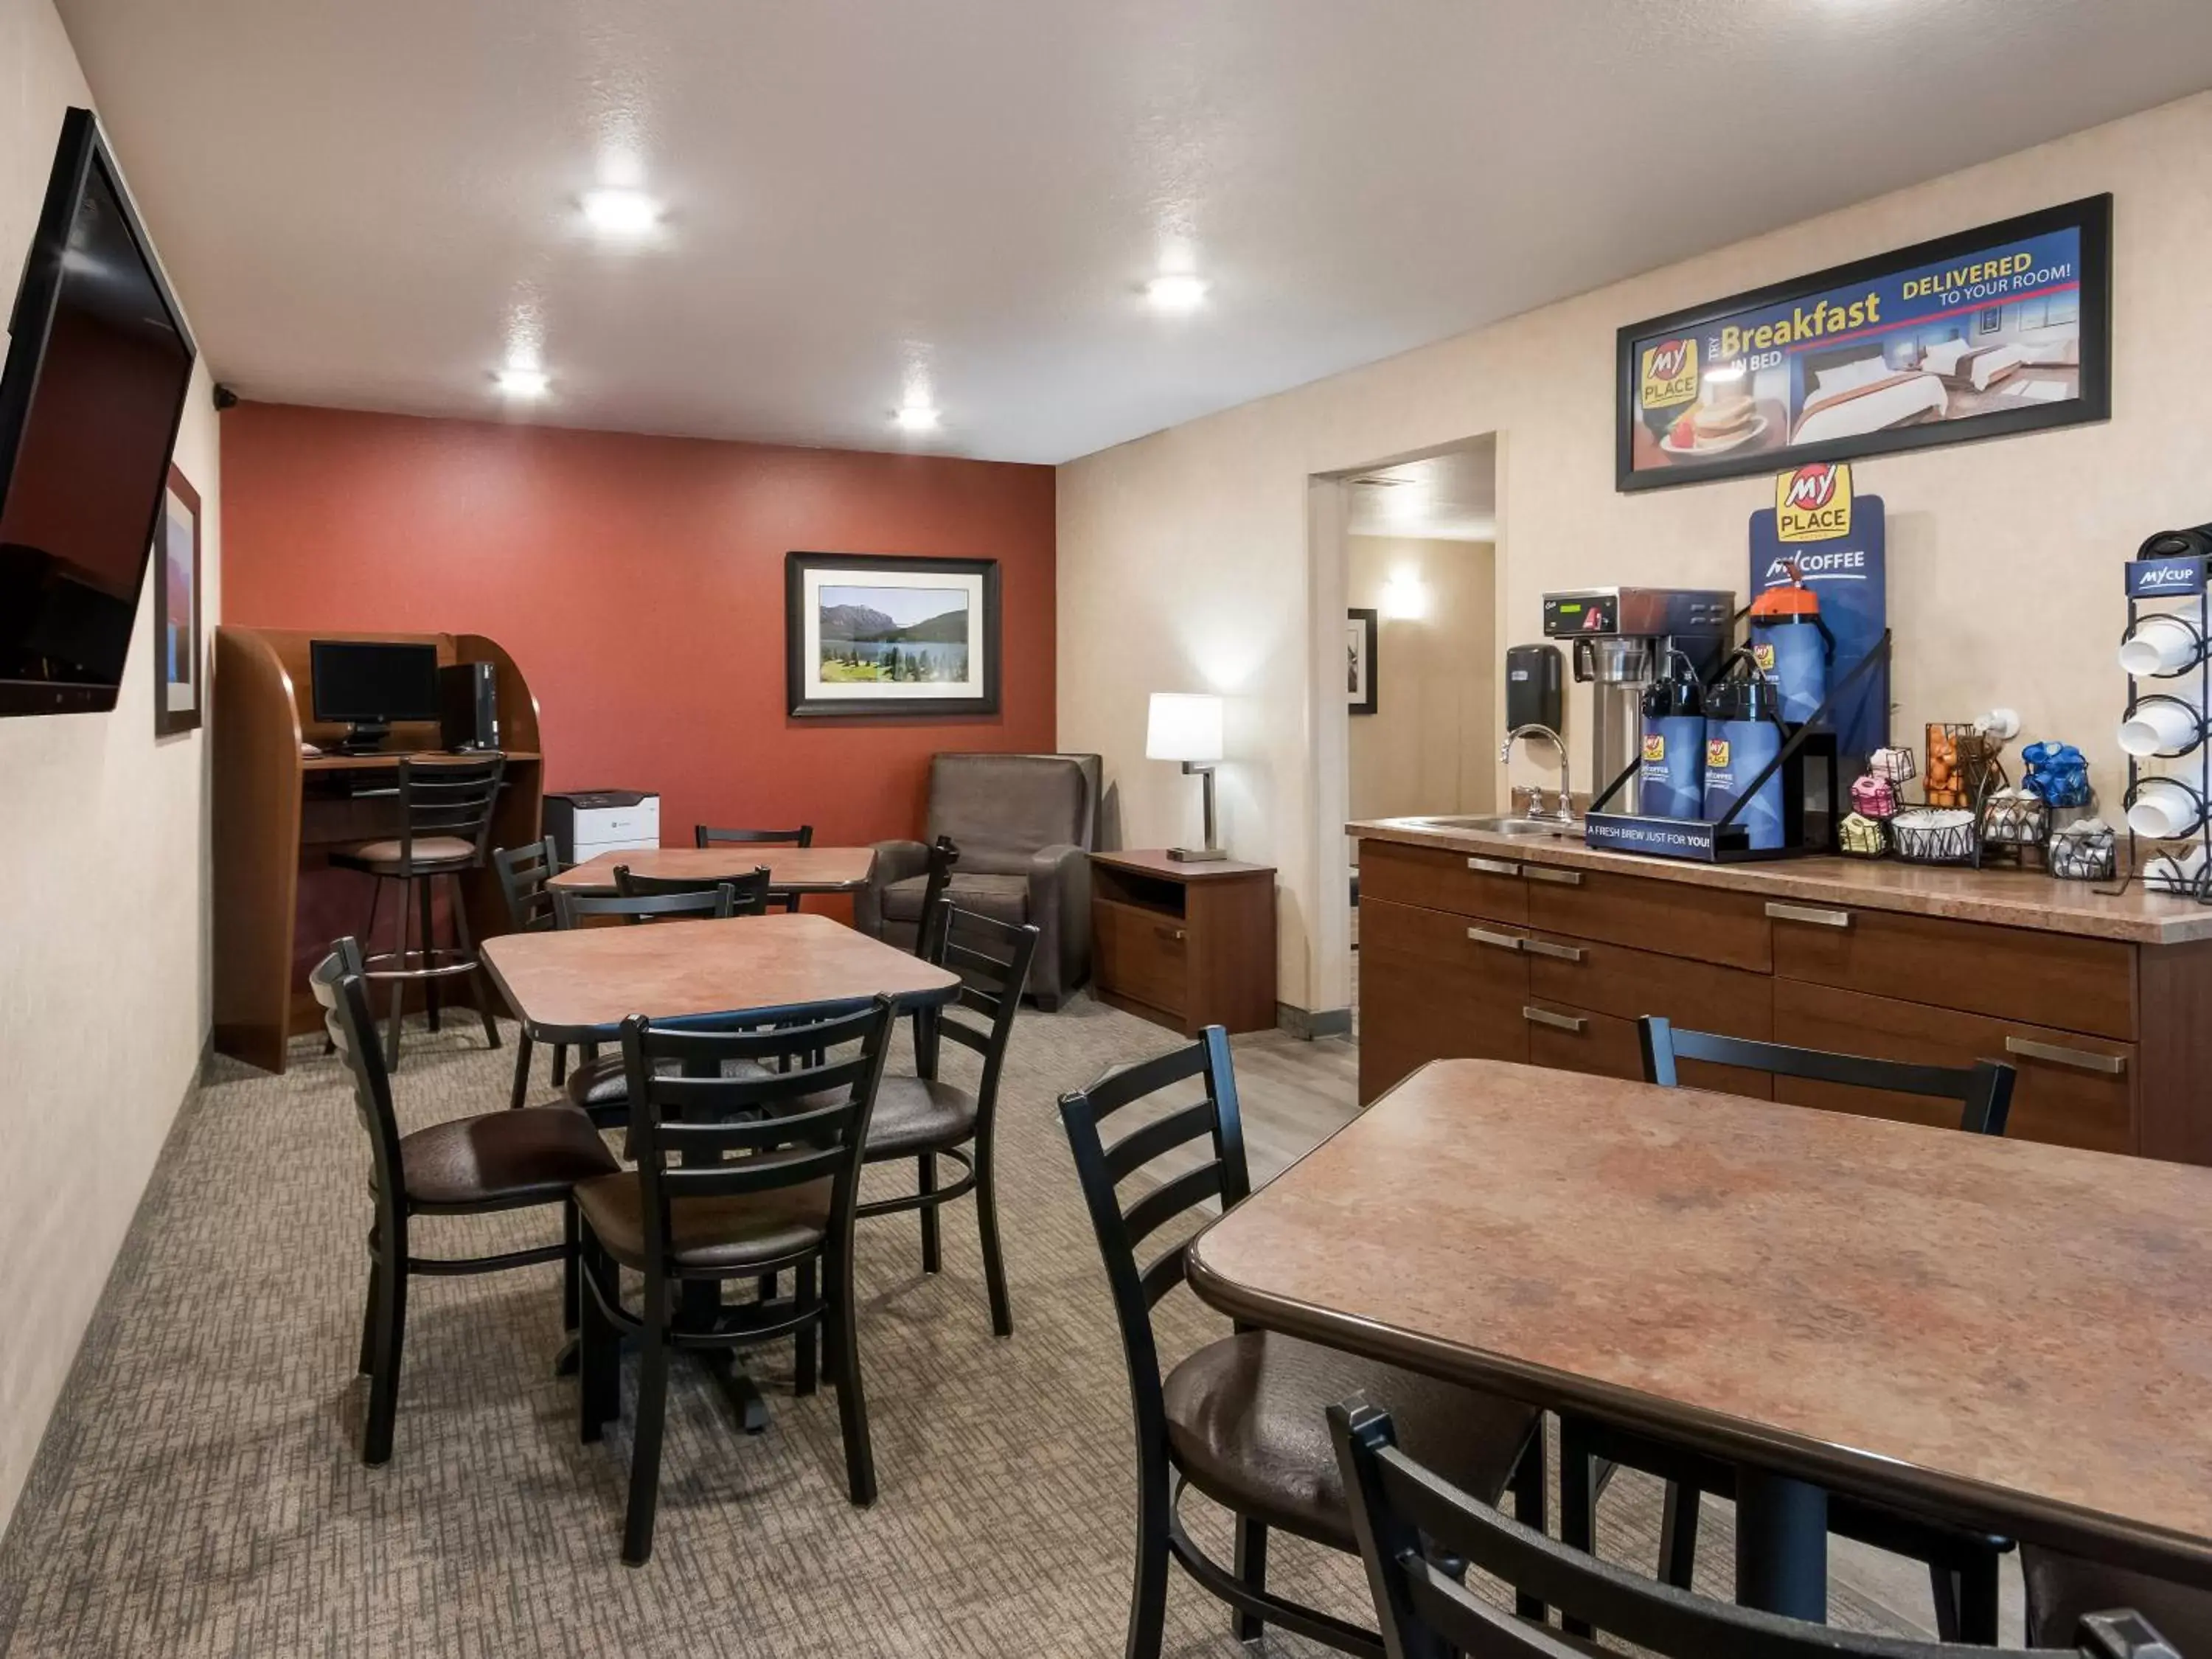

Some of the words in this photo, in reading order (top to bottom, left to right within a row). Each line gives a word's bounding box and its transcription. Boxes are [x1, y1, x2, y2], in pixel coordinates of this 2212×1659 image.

[1903, 253, 2032, 300] DELIVERED
[1939, 291, 1960, 306] TO
[1964, 279, 2008, 299] YOUR
[2012, 263, 2070, 290] ROOM!
[1721, 292, 1880, 358] Breakfast
[1750, 350, 1782, 371] BED
[1645, 377, 1694, 400] PLACE
[1781, 508, 1847, 532] PLACE
[1588, 825, 1593, 834] A
[1595, 826, 1620, 838] FRESH
[1621, 828, 1644, 840] BREW
[1645, 832, 1666, 843] JUST
[1667, 834, 1686, 845] FOR
[1687, 835, 1710, 848] YOU!
